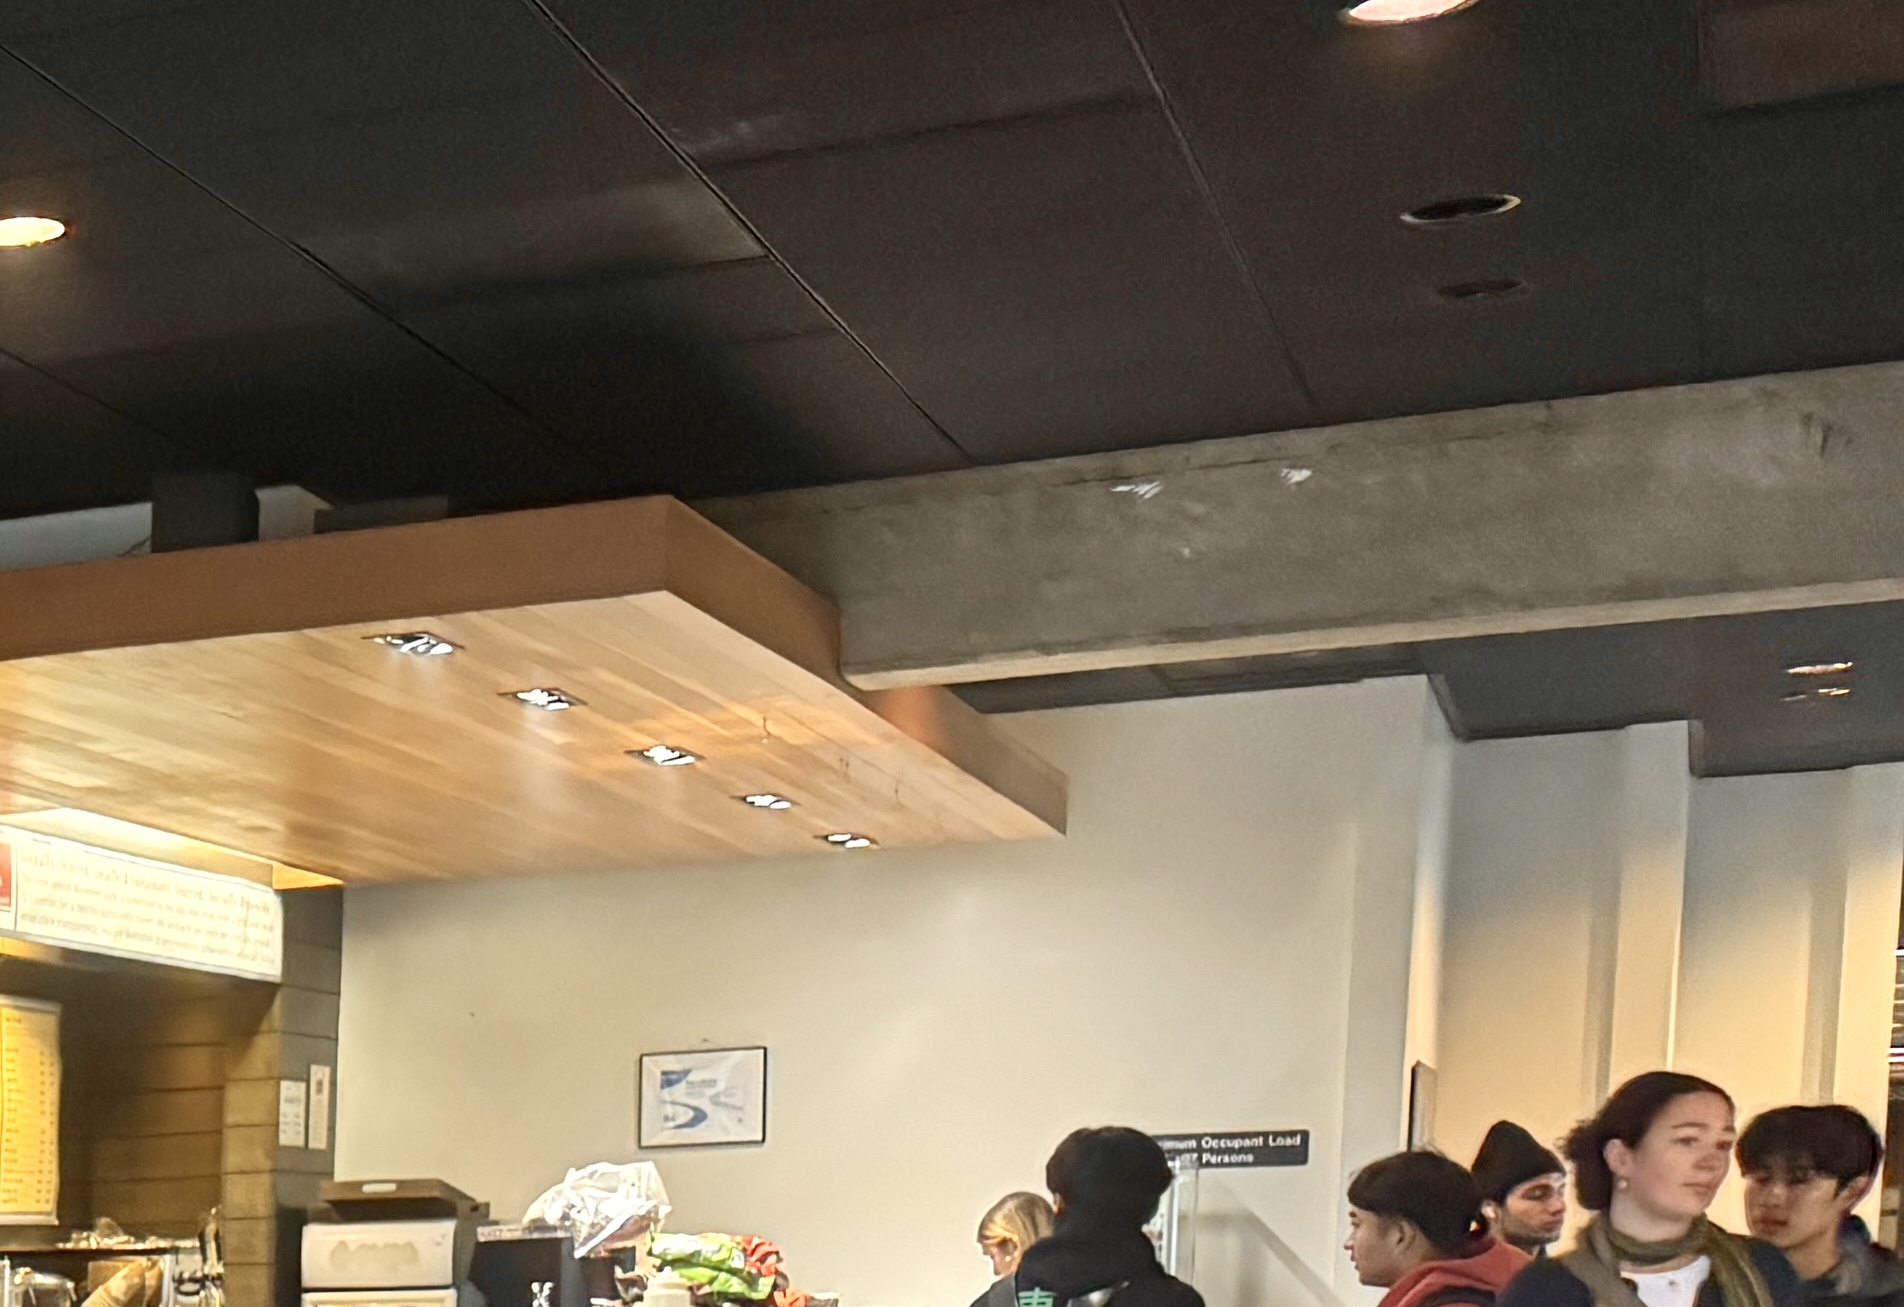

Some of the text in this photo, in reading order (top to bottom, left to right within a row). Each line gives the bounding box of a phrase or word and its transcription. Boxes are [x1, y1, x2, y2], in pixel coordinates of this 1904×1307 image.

[1201, 1134, 1263, 1149] Occupant
[1268, 1134, 1301, 1147] Load
[1202, 1153, 1253, 1164] Persons
